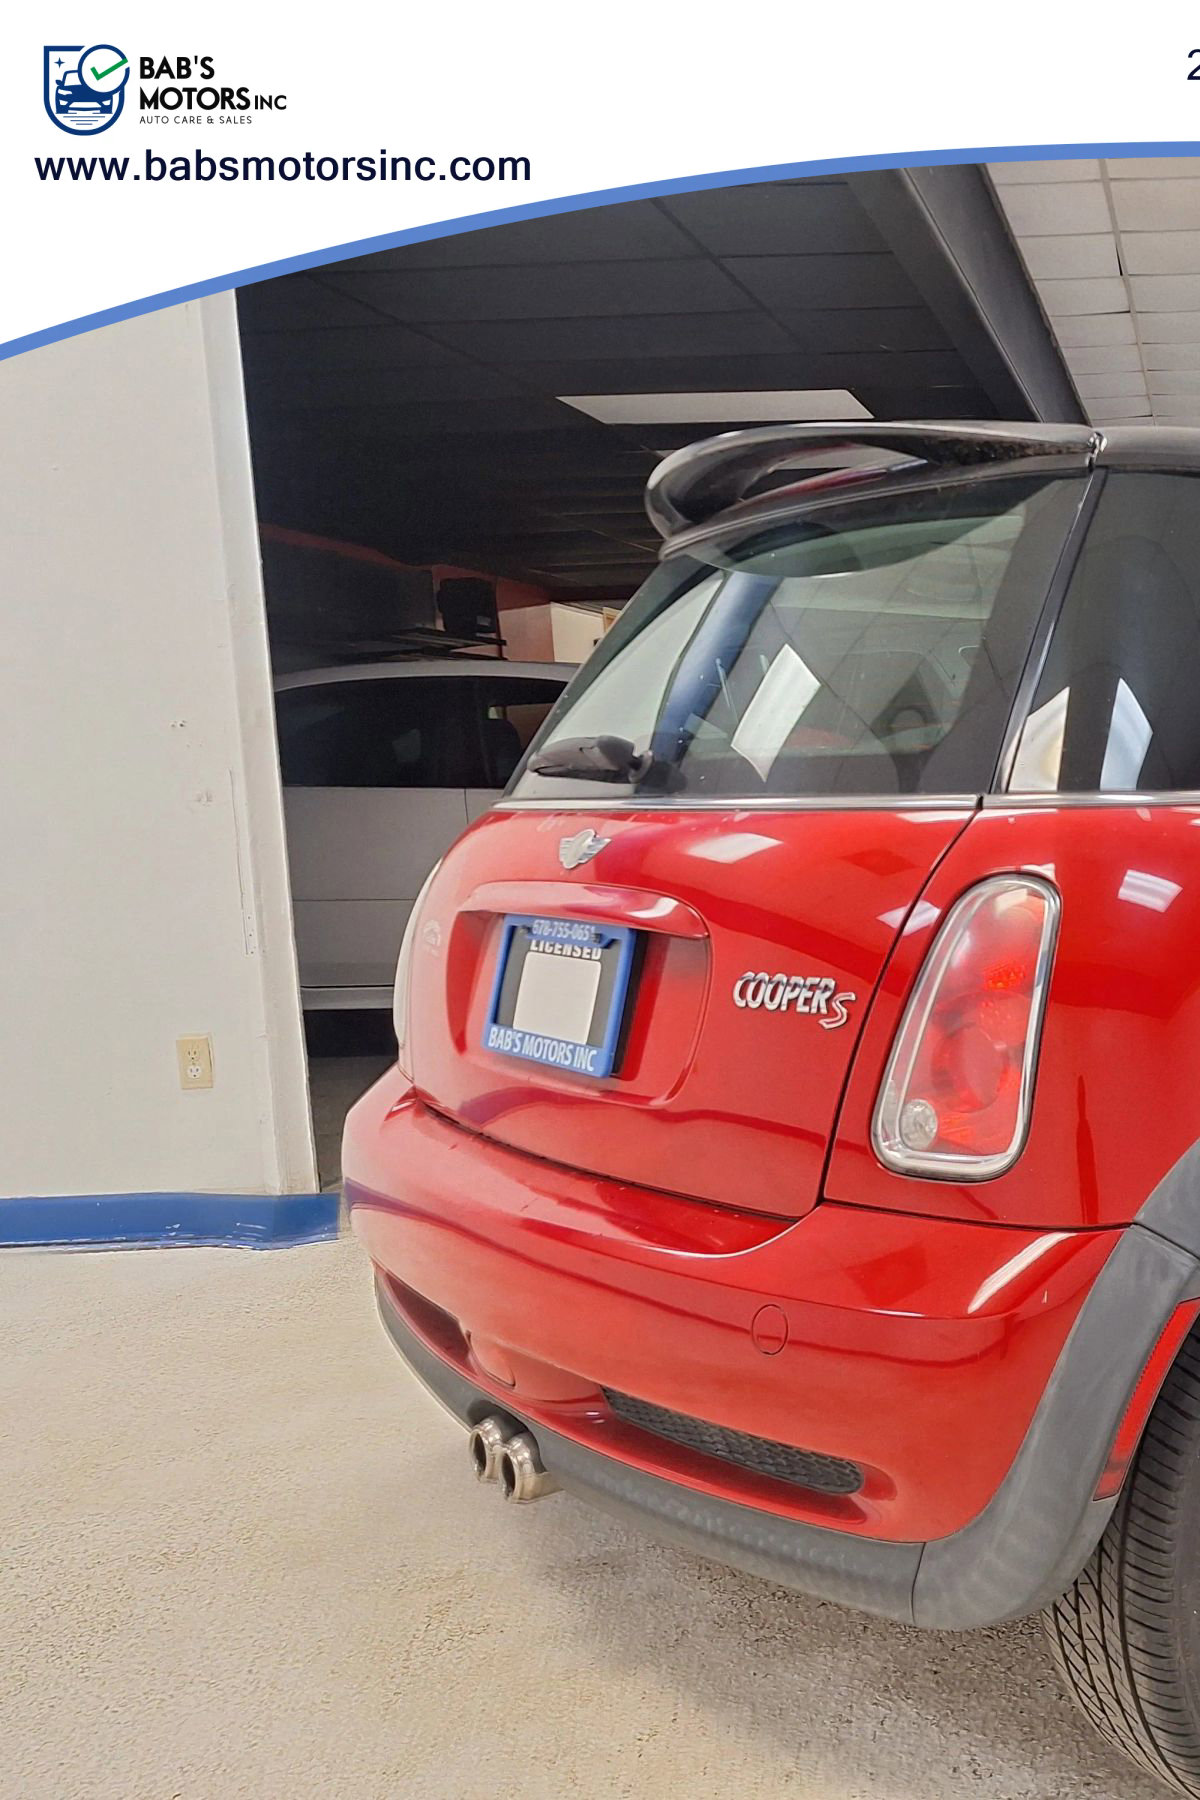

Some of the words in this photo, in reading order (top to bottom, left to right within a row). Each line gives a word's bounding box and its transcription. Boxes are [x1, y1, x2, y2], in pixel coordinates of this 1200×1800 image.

[733, 971, 837, 1014] COOPER
[818, 991, 857, 1031] S
[488, 1027, 521, 1053] BAB'S
[521, 1033, 574, 1066] MOTORS
[573, 1046, 598, 1072] INC
